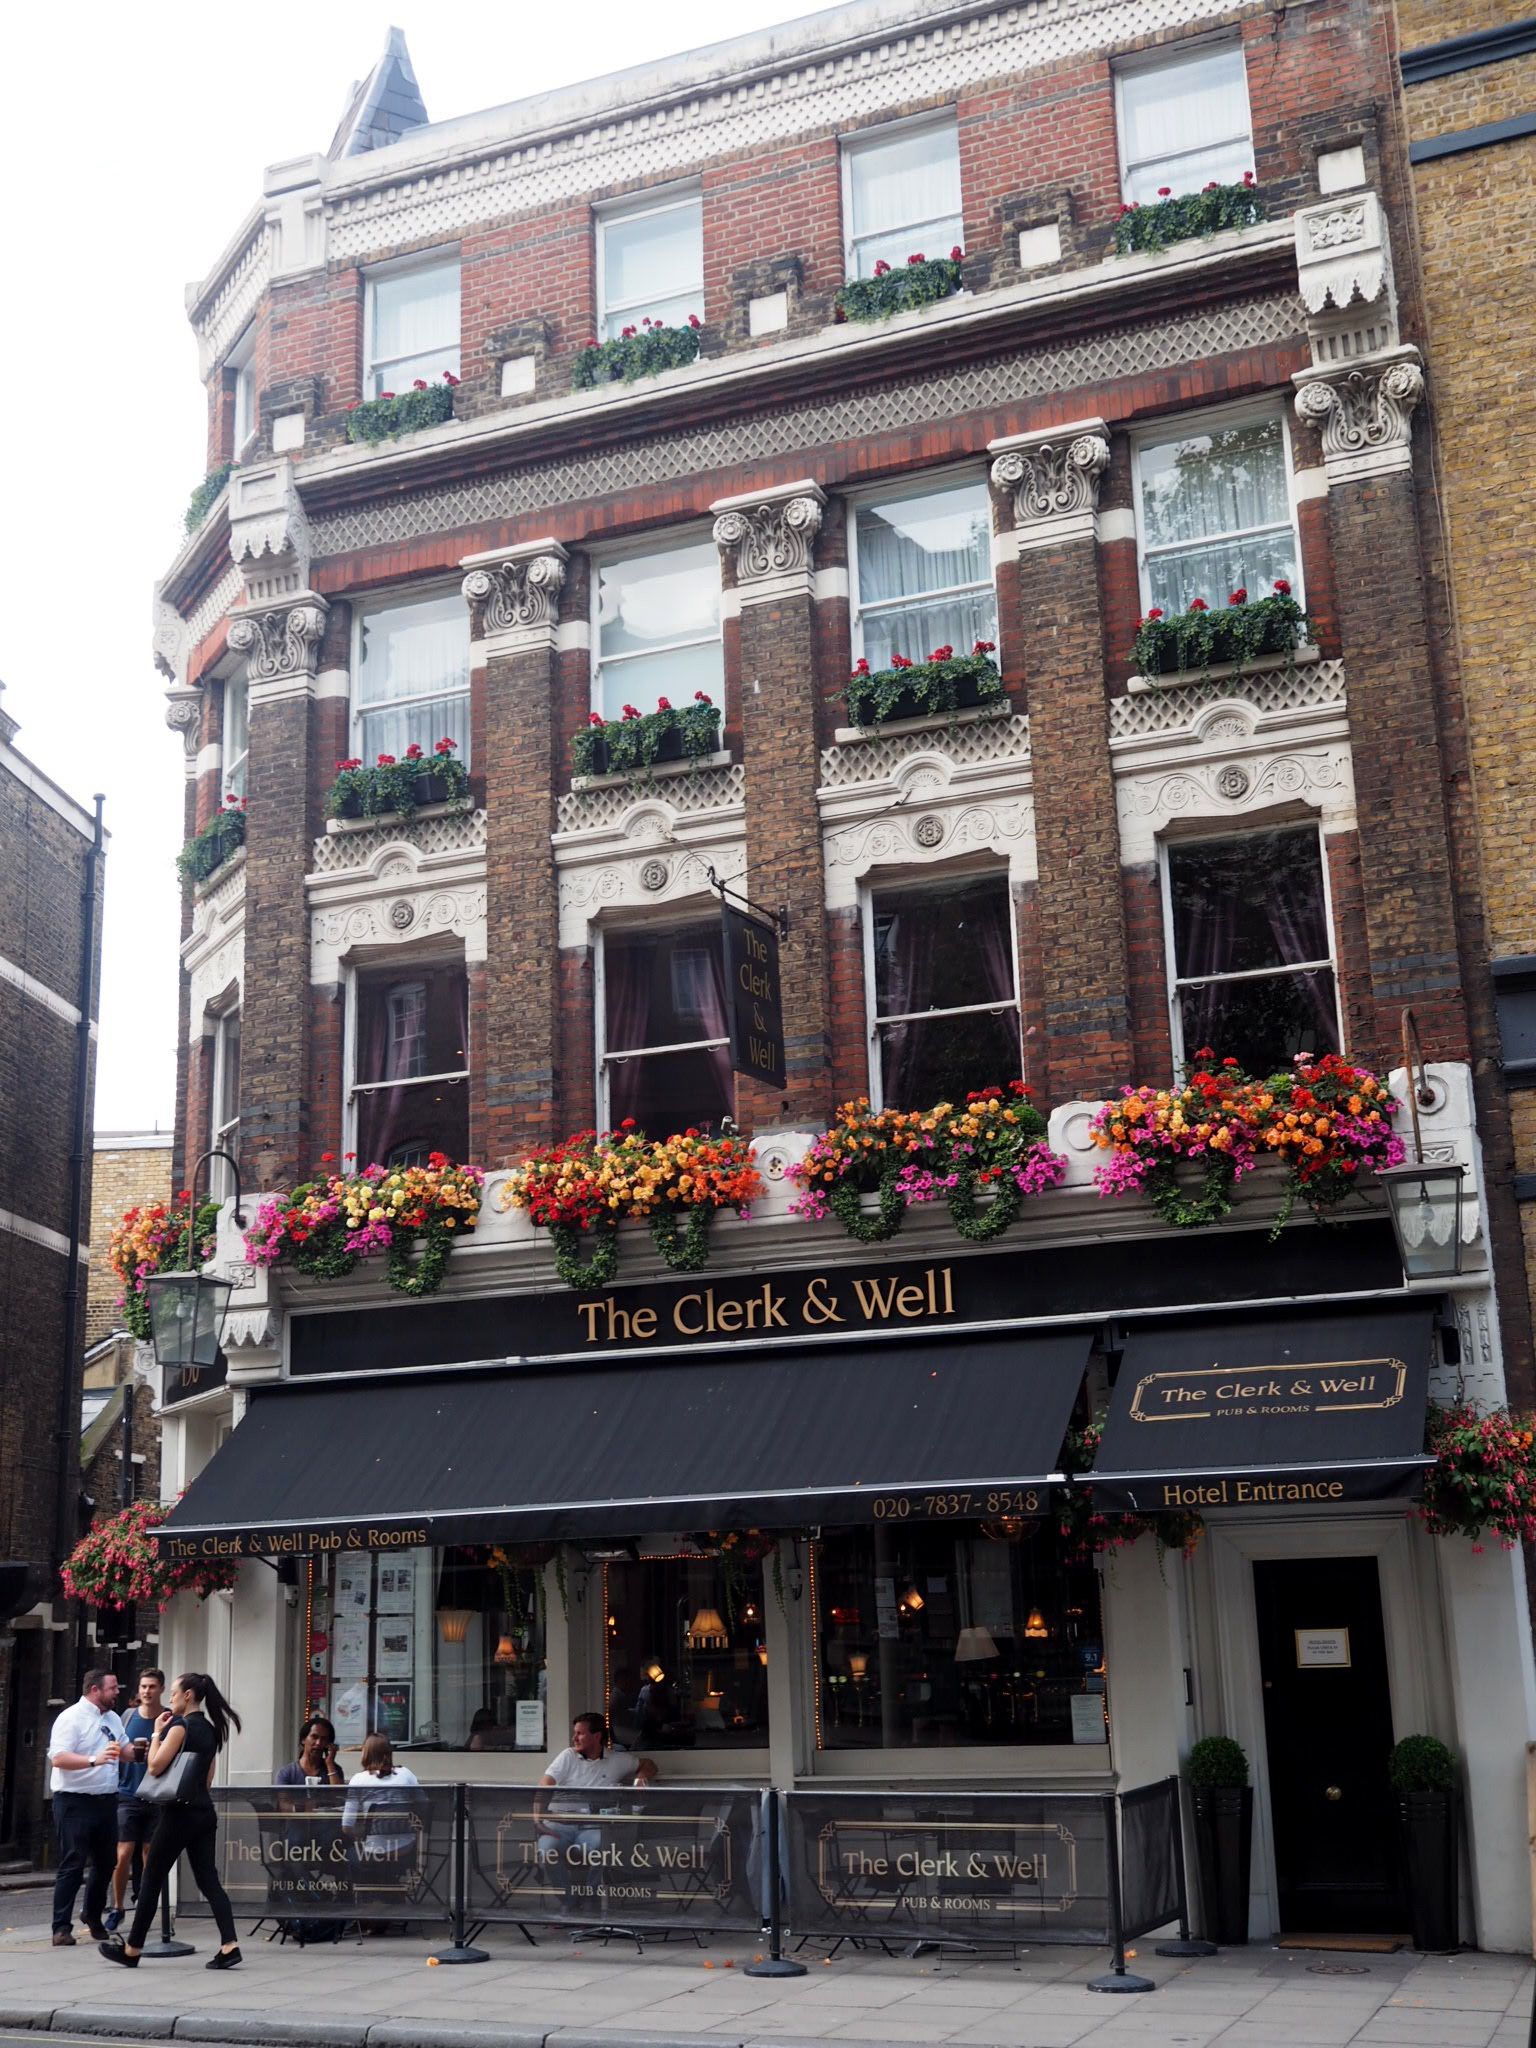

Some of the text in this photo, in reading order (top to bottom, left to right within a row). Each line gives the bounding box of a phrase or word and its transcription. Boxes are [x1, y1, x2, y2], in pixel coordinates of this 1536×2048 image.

[743, 928, 768, 963] The
[740, 964, 772, 1001] Clerk
[753, 1002, 767, 1033] &
[749, 1036, 775, 1072] Well
[577, 1268, 956, 1342] The Clerk & Well
[1161, 1376, 1376, 1403] The Clerk & Well
[1217, 1404, 1310, 1417] PUB & ROOMS
[1163, 1480, 1344, 1506] Hotel Entrance
[168, 1527, 427, 1556] The Clerk & Well Pub & Rooms
[225, 1839, 399, 1862] The Clerk & Well
[519, 1842, 705, 1868] The Clerk & Well
[842, 1851, 1048, 1879] The Clerk & Well
[272, 1880, 349, 1891] PUB & ROOMS
[570, 1885, 651, 1898] PUB & ROOMS
[901, 1897, 991, 1910] PUB & ROOMS
